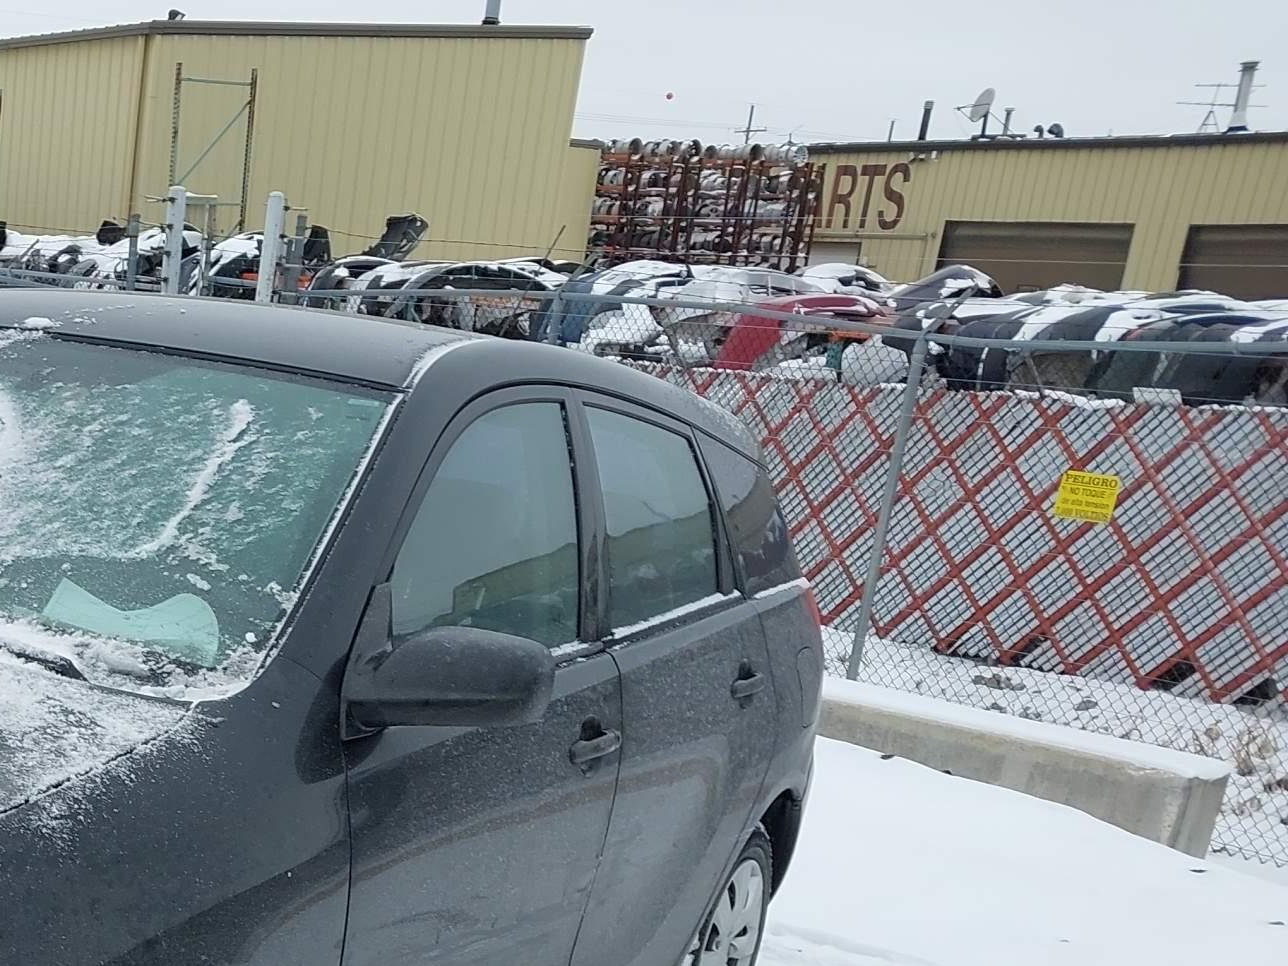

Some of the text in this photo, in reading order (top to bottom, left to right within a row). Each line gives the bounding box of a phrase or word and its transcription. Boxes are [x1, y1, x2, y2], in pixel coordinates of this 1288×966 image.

[1065, 474, 1118, 488] PELIGRO
[1070, 487, 1106, 498] NO TOQUE
